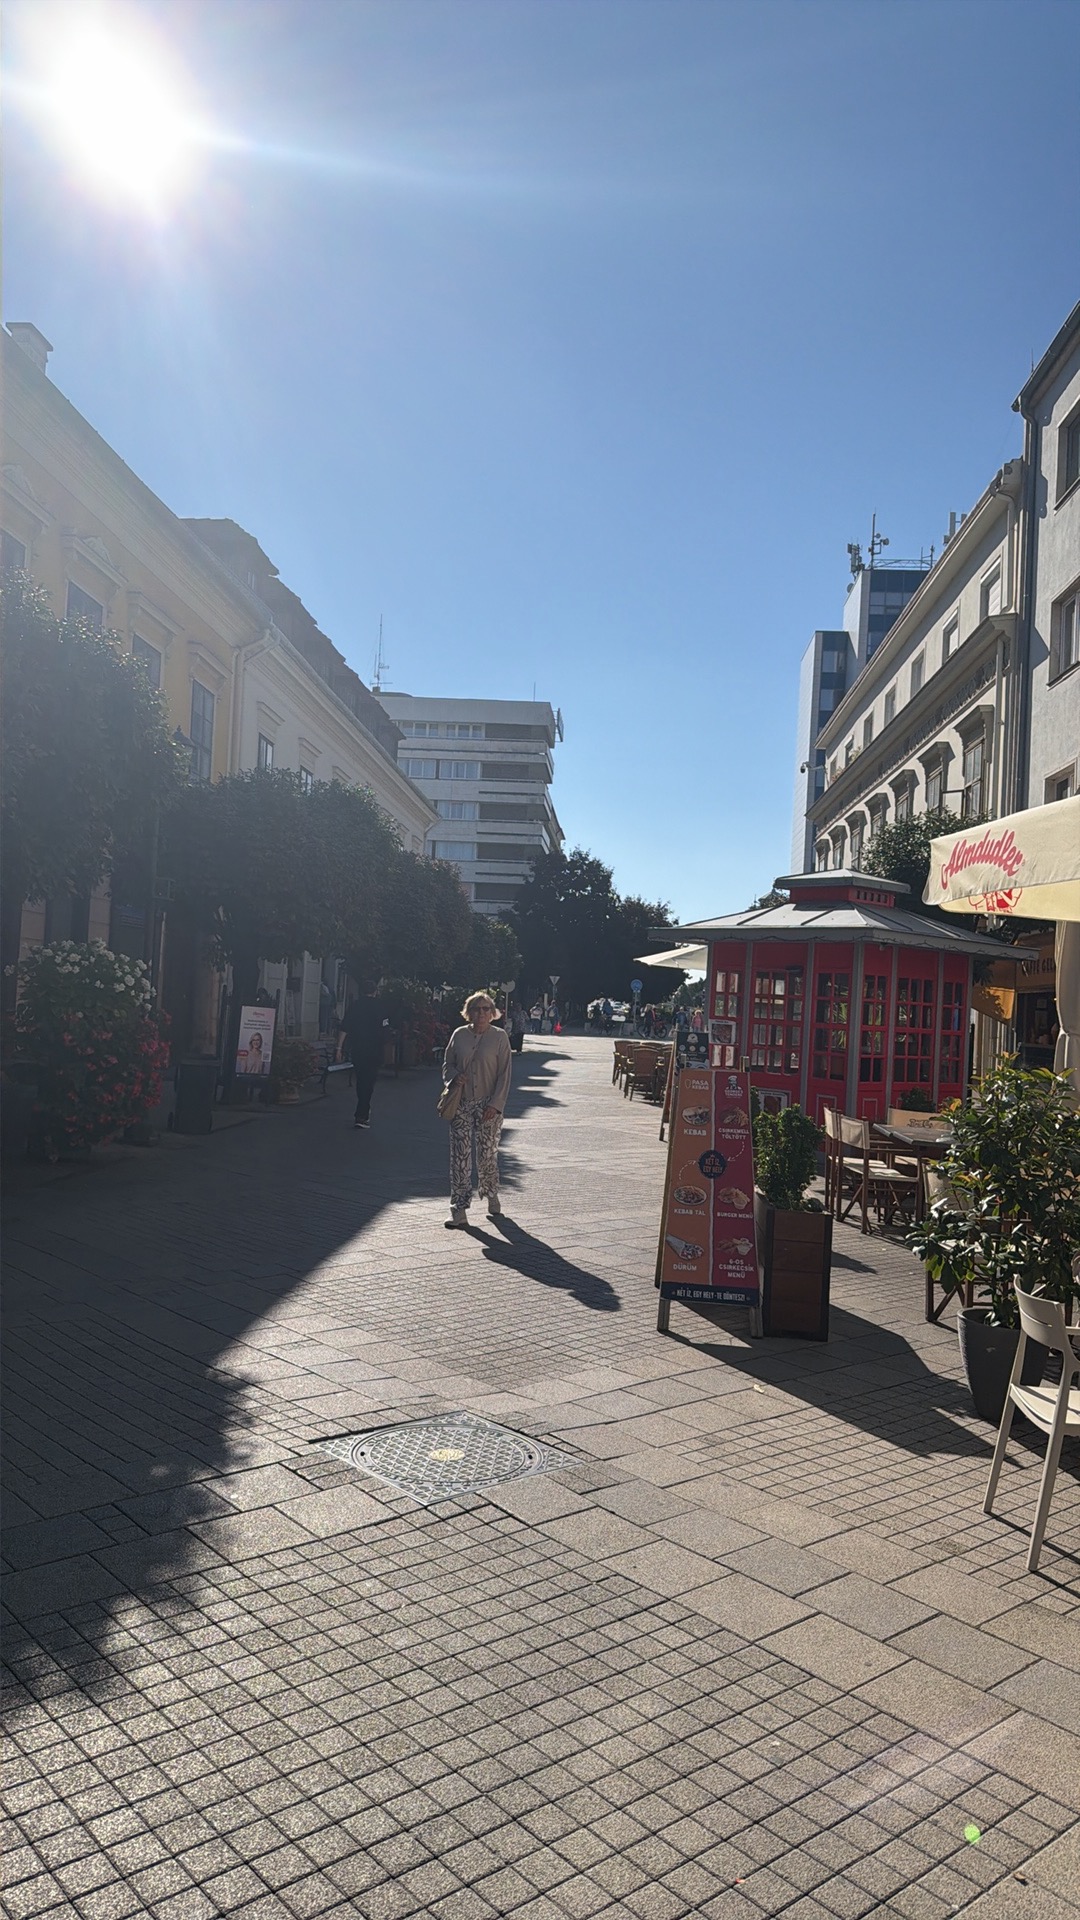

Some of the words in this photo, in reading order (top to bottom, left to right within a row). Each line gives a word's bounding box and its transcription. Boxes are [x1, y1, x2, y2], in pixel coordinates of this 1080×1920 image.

[941, 830, 1023, 890] Almdudler
[719, 1264, 754, 1272] CSIRKECSÍK
[677, 1287, 685, 1296] KÉT
